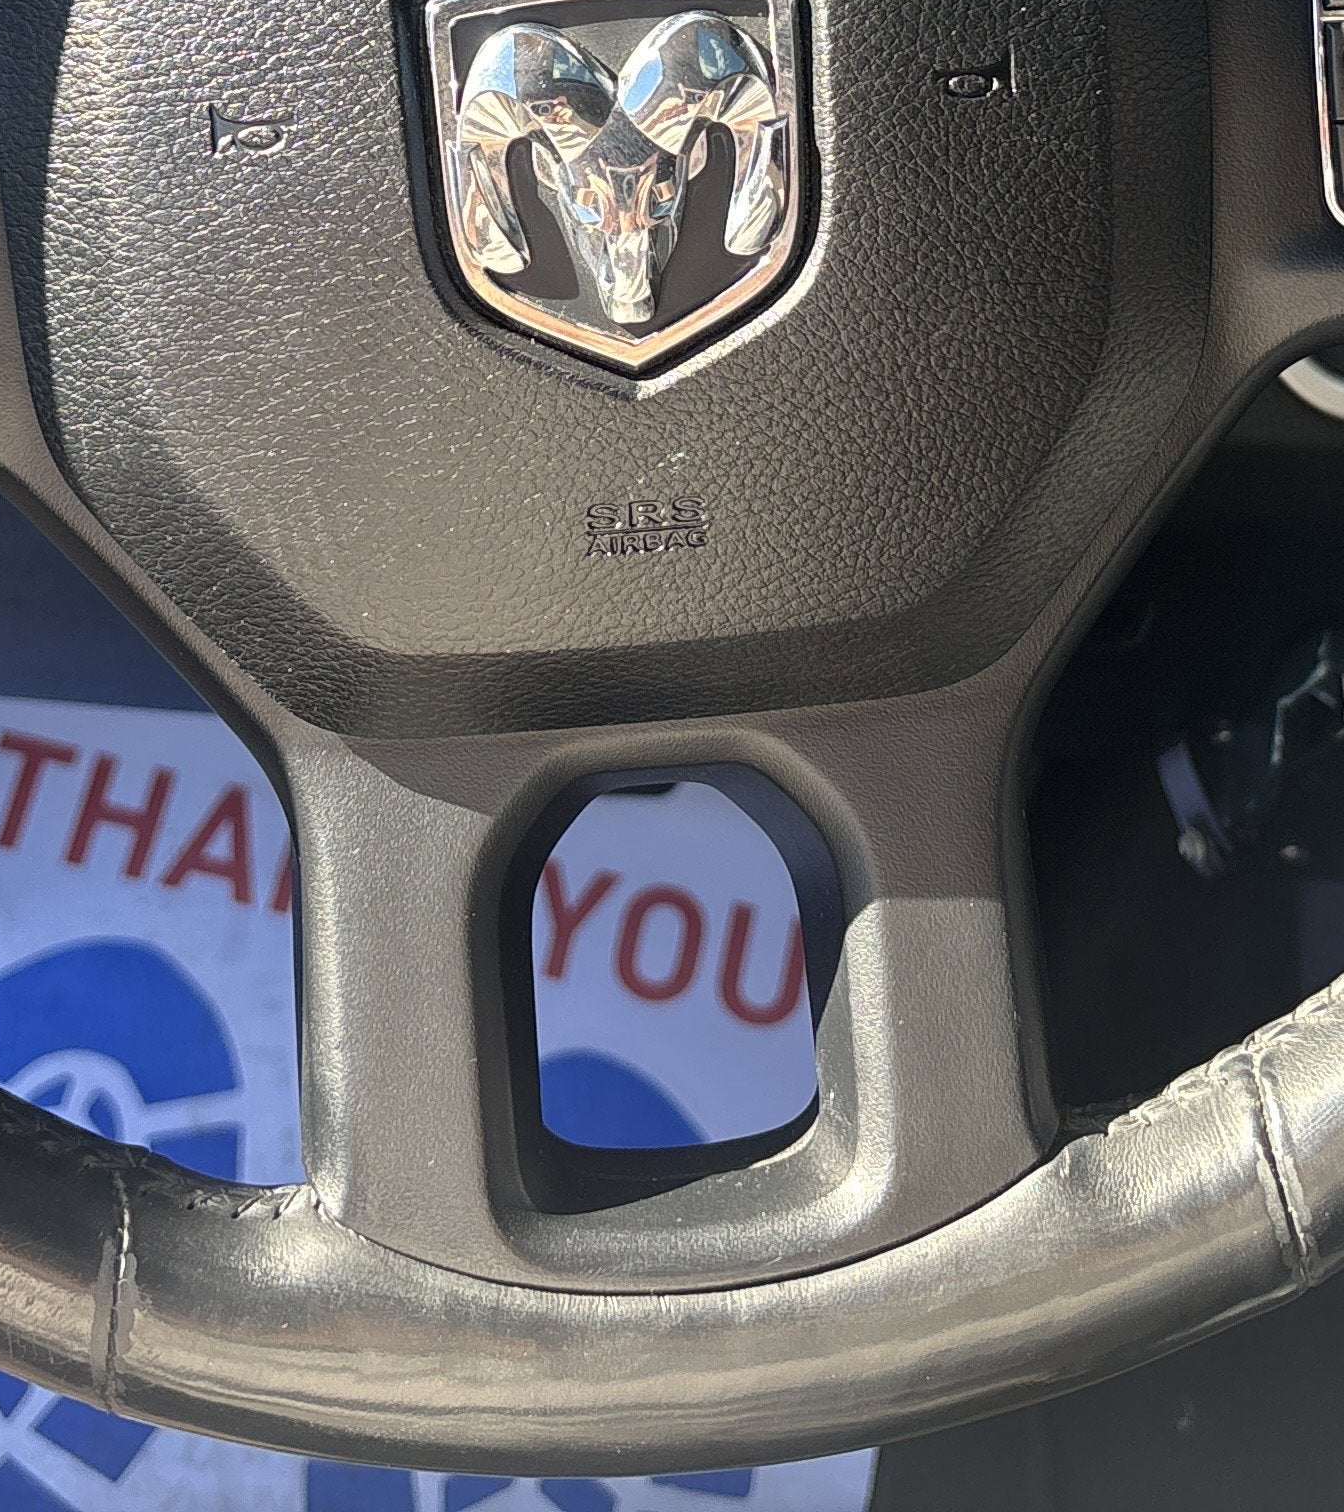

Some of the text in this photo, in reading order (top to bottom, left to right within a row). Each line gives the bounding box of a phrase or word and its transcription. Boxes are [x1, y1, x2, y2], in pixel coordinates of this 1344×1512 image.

[587, 496, 707, 530] SRS
[587, 530, 708, 557] AIRBAG
[541, 857, 809, 1027] YOU
